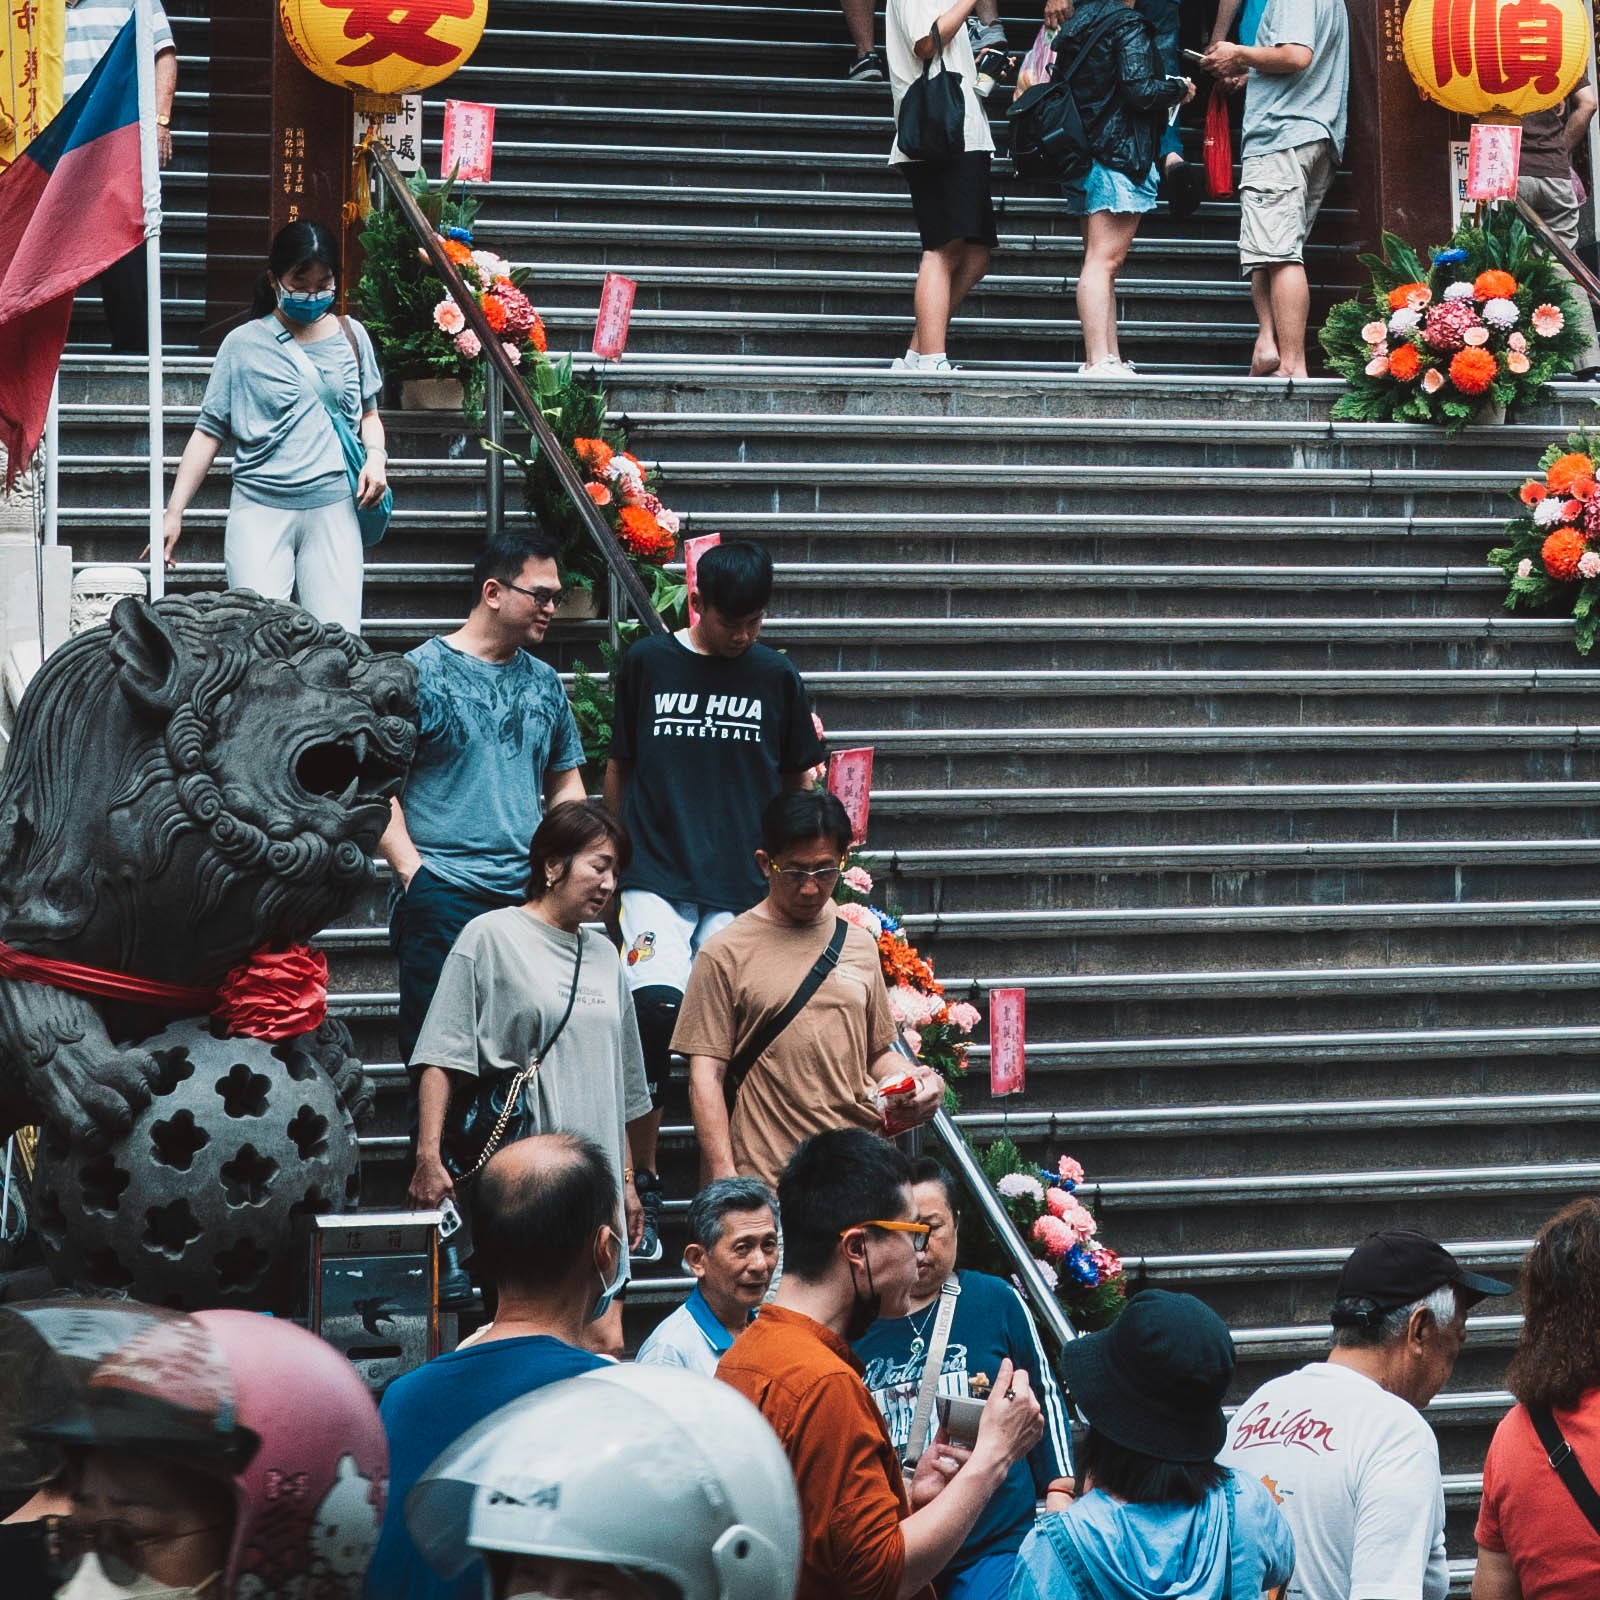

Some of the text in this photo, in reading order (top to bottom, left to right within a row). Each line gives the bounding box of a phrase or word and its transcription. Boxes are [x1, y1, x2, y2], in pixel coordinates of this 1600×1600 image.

[654, 694, 763, 720] WU HUA
[653, 726, 762, 742] BASKETBALL
